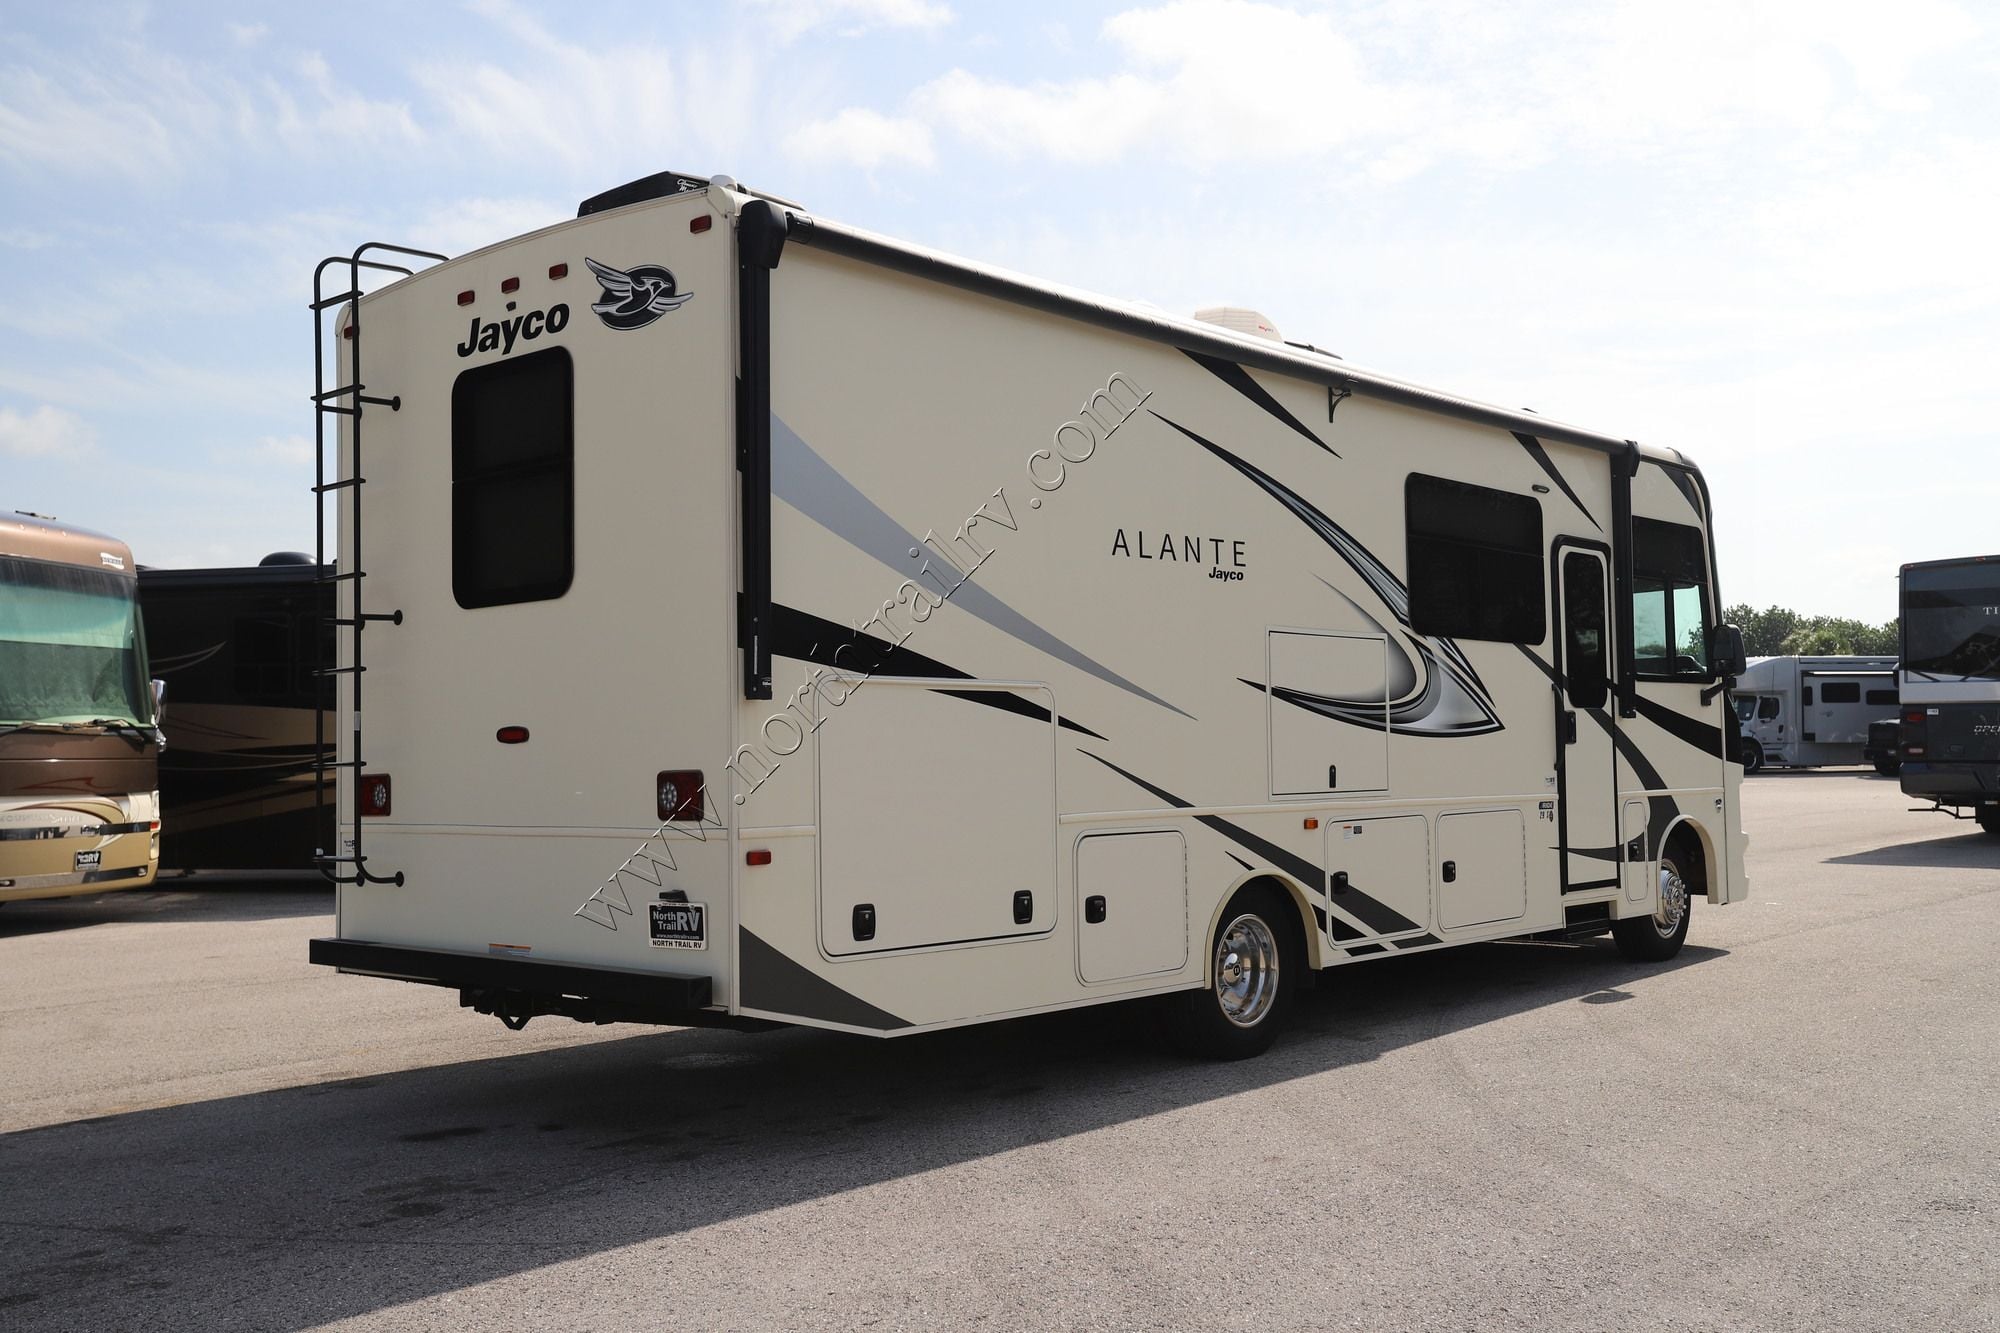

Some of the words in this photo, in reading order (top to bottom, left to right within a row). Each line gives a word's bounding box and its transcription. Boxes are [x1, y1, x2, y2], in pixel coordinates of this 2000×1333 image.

[457, 302, 570, 358] Jayco
[1111, 528, 1247, 568] ALANTE
[1208, 566, 1244, 582] Jayco
[653, 911, 676, 920] North
[677, 911, 700, 931] RV
[657, 920, 676, 930] Trail
[652, 939, 673, 947] NORTH
[674, 940, 692, 948] TRAIL
